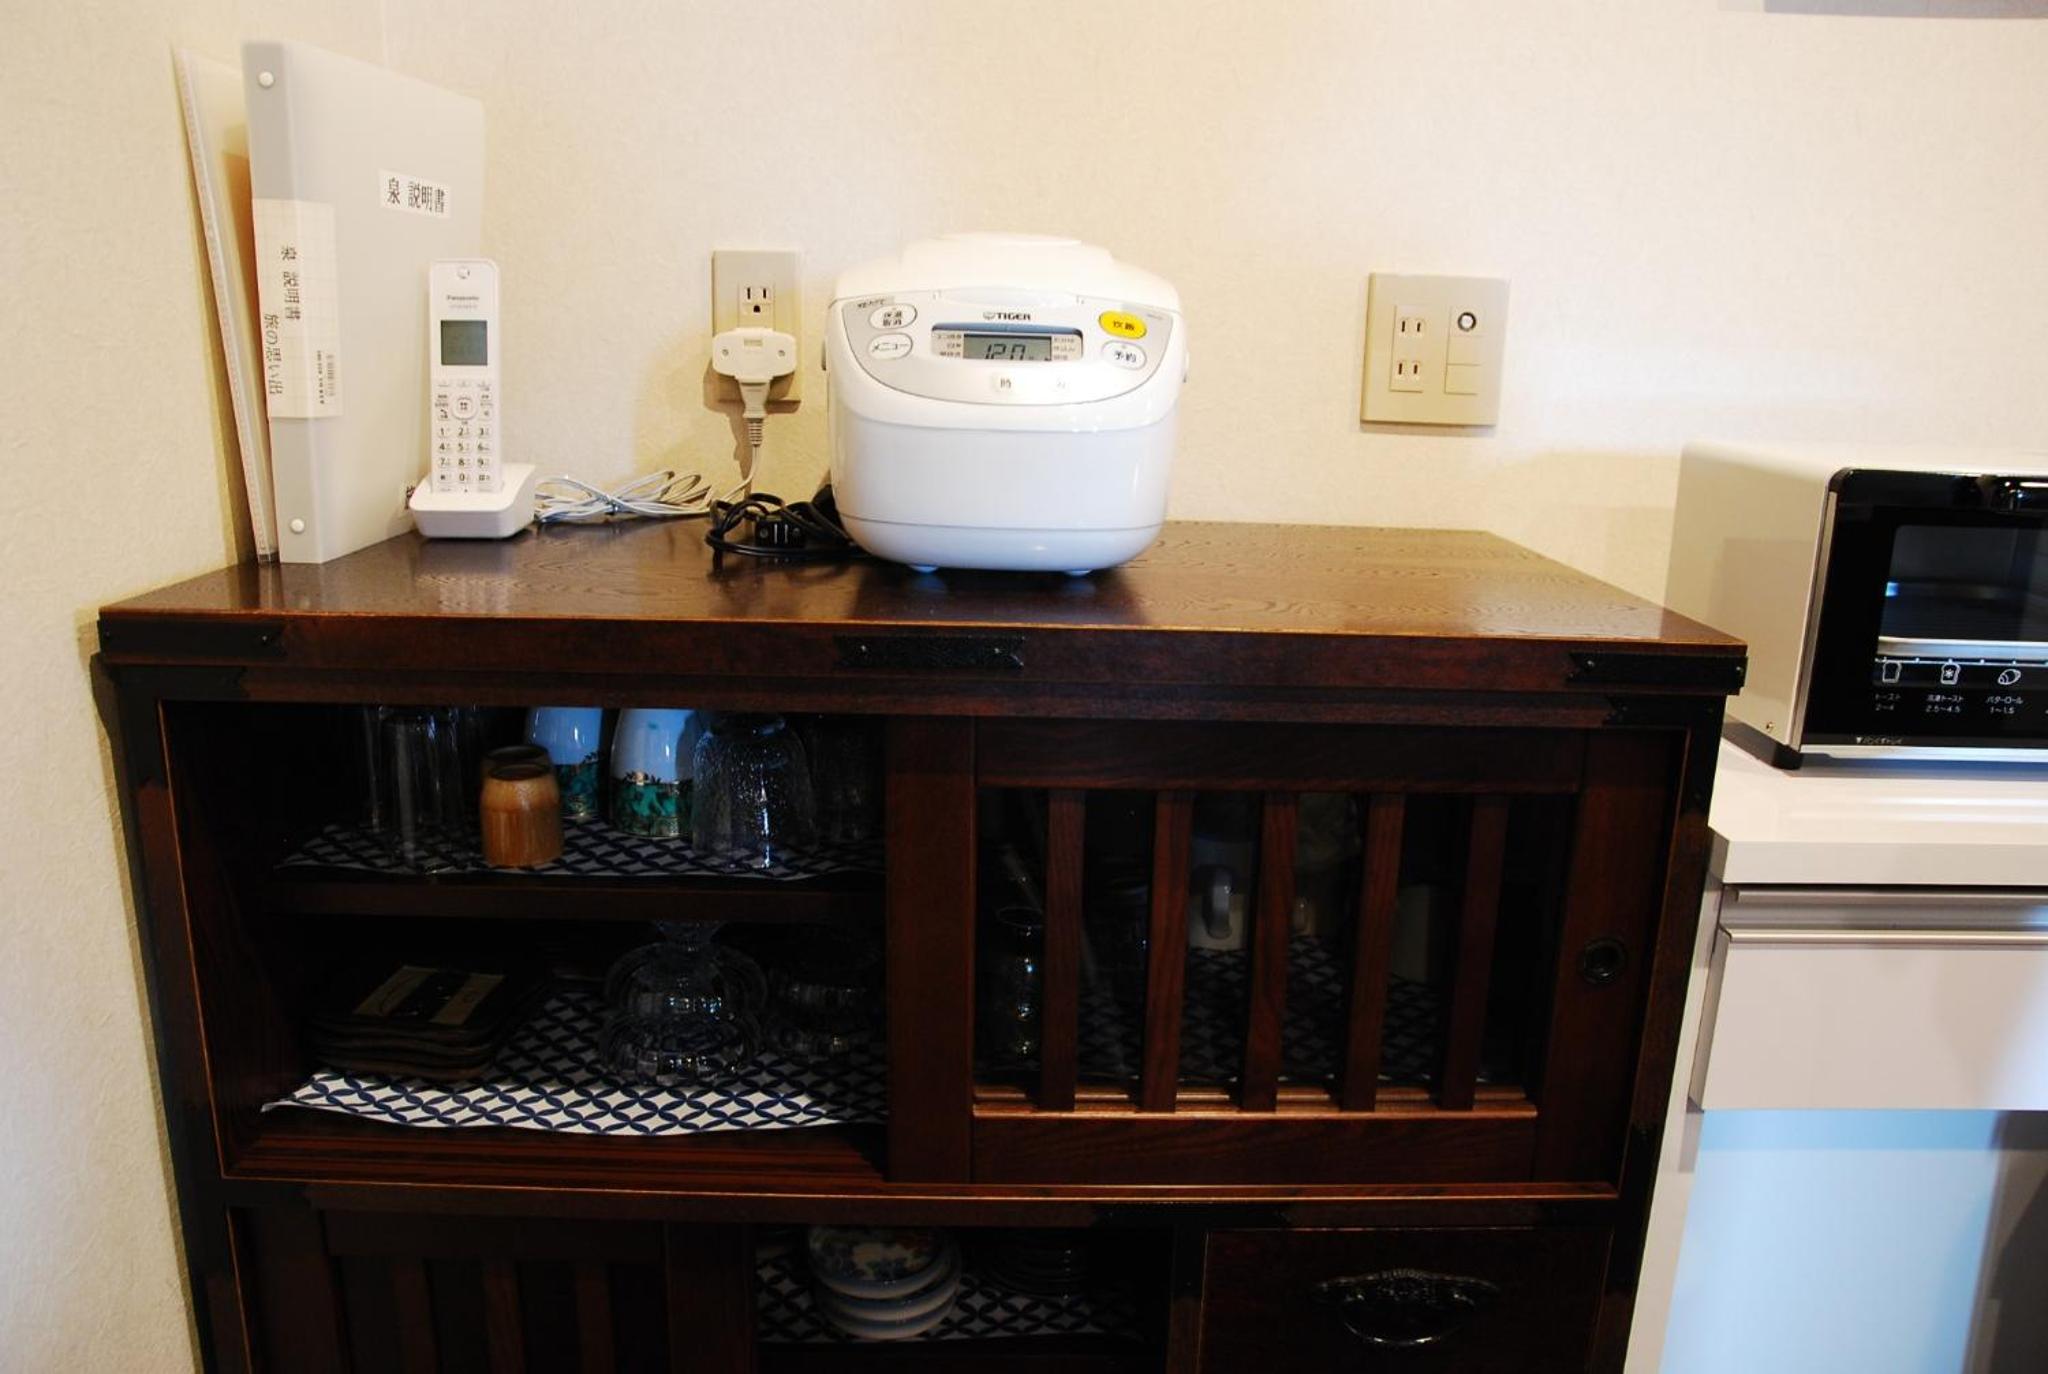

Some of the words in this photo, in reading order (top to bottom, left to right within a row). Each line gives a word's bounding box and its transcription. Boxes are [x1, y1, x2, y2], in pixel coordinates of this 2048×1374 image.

[387, 177, 400, 204] 泉
[408, 181, 445, 213] 説明書
[283, 271, 301, 320] 説明書
[996, 312, 1031, 321] TIGER
[264, 314, 283, 395] 旅の思い出
[872, 342, 909, 353] メニュー
